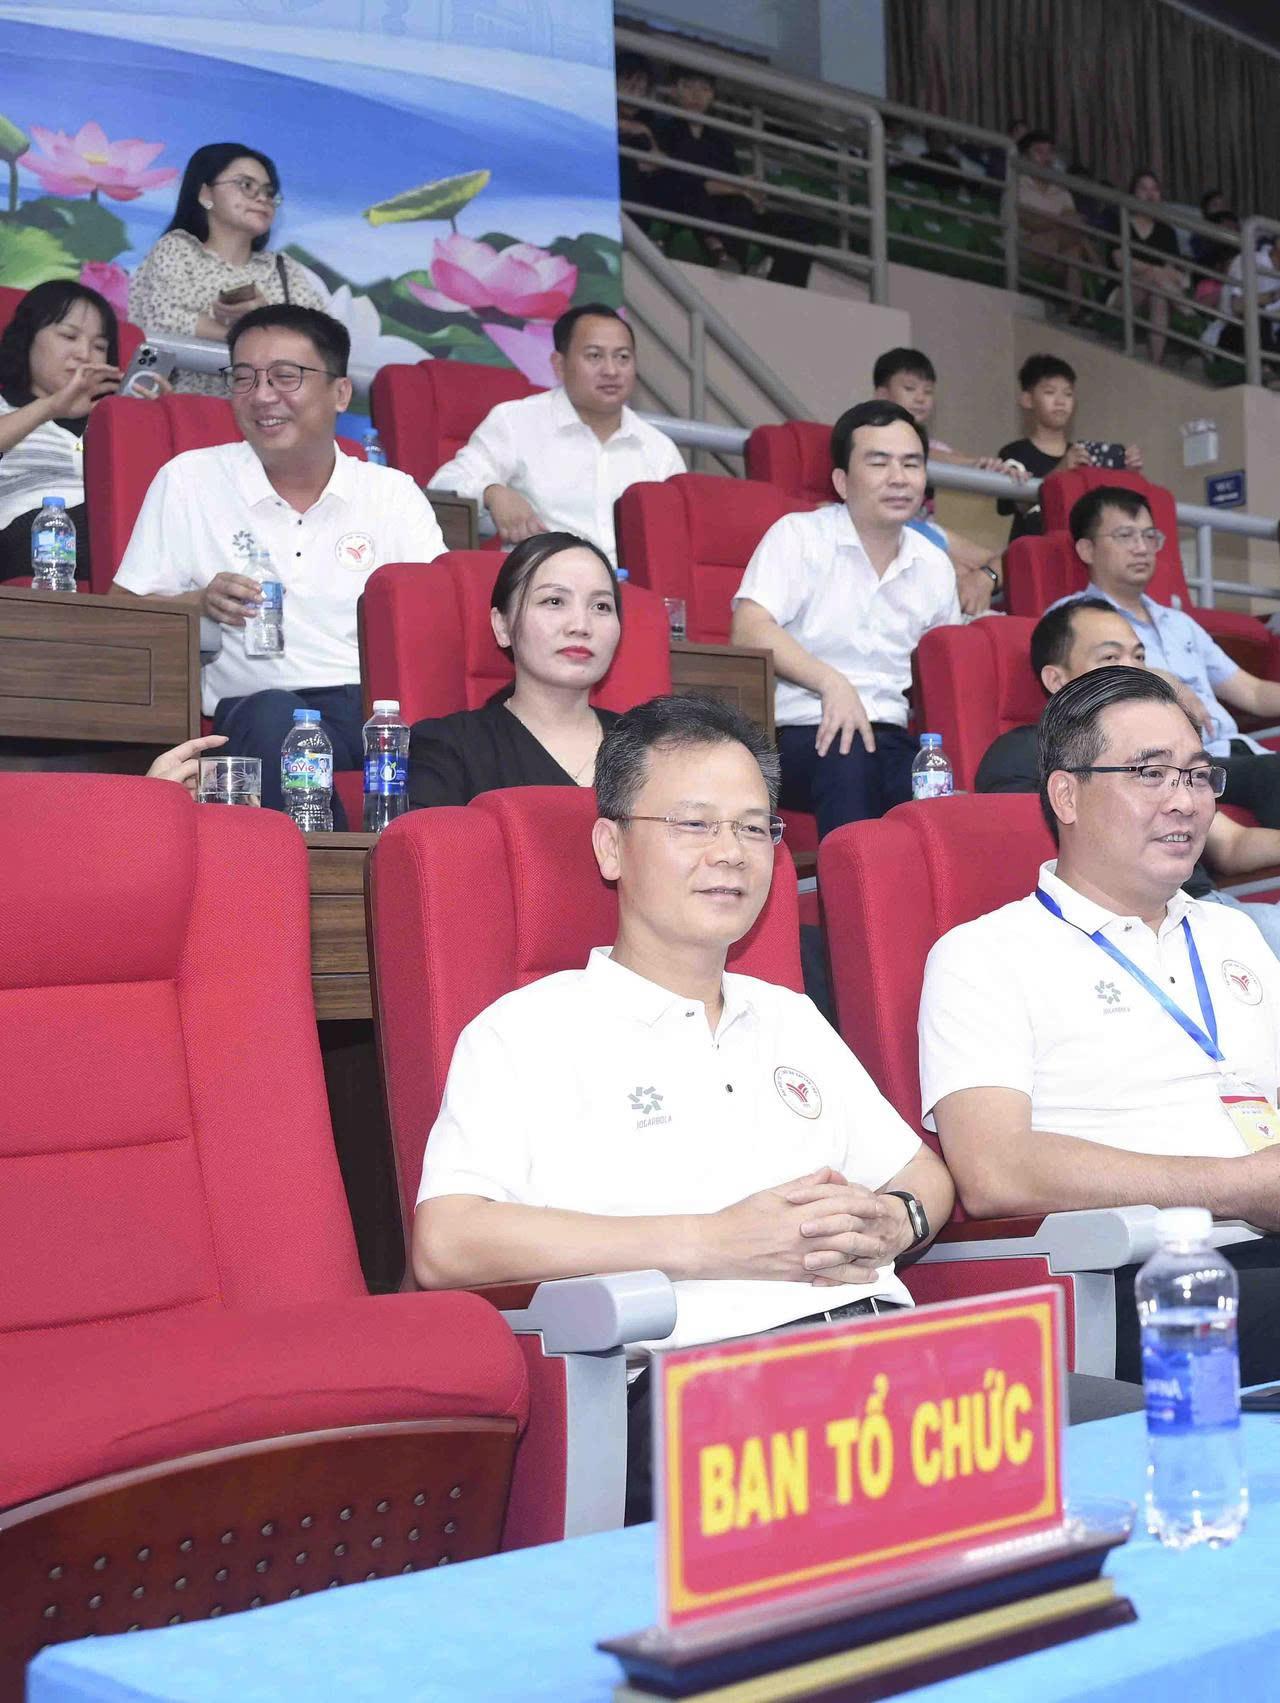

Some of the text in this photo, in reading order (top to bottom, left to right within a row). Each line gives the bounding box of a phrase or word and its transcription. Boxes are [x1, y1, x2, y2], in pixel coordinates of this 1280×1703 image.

[700, 1368, 1033, 1536] BAN TỔ CHỨC
